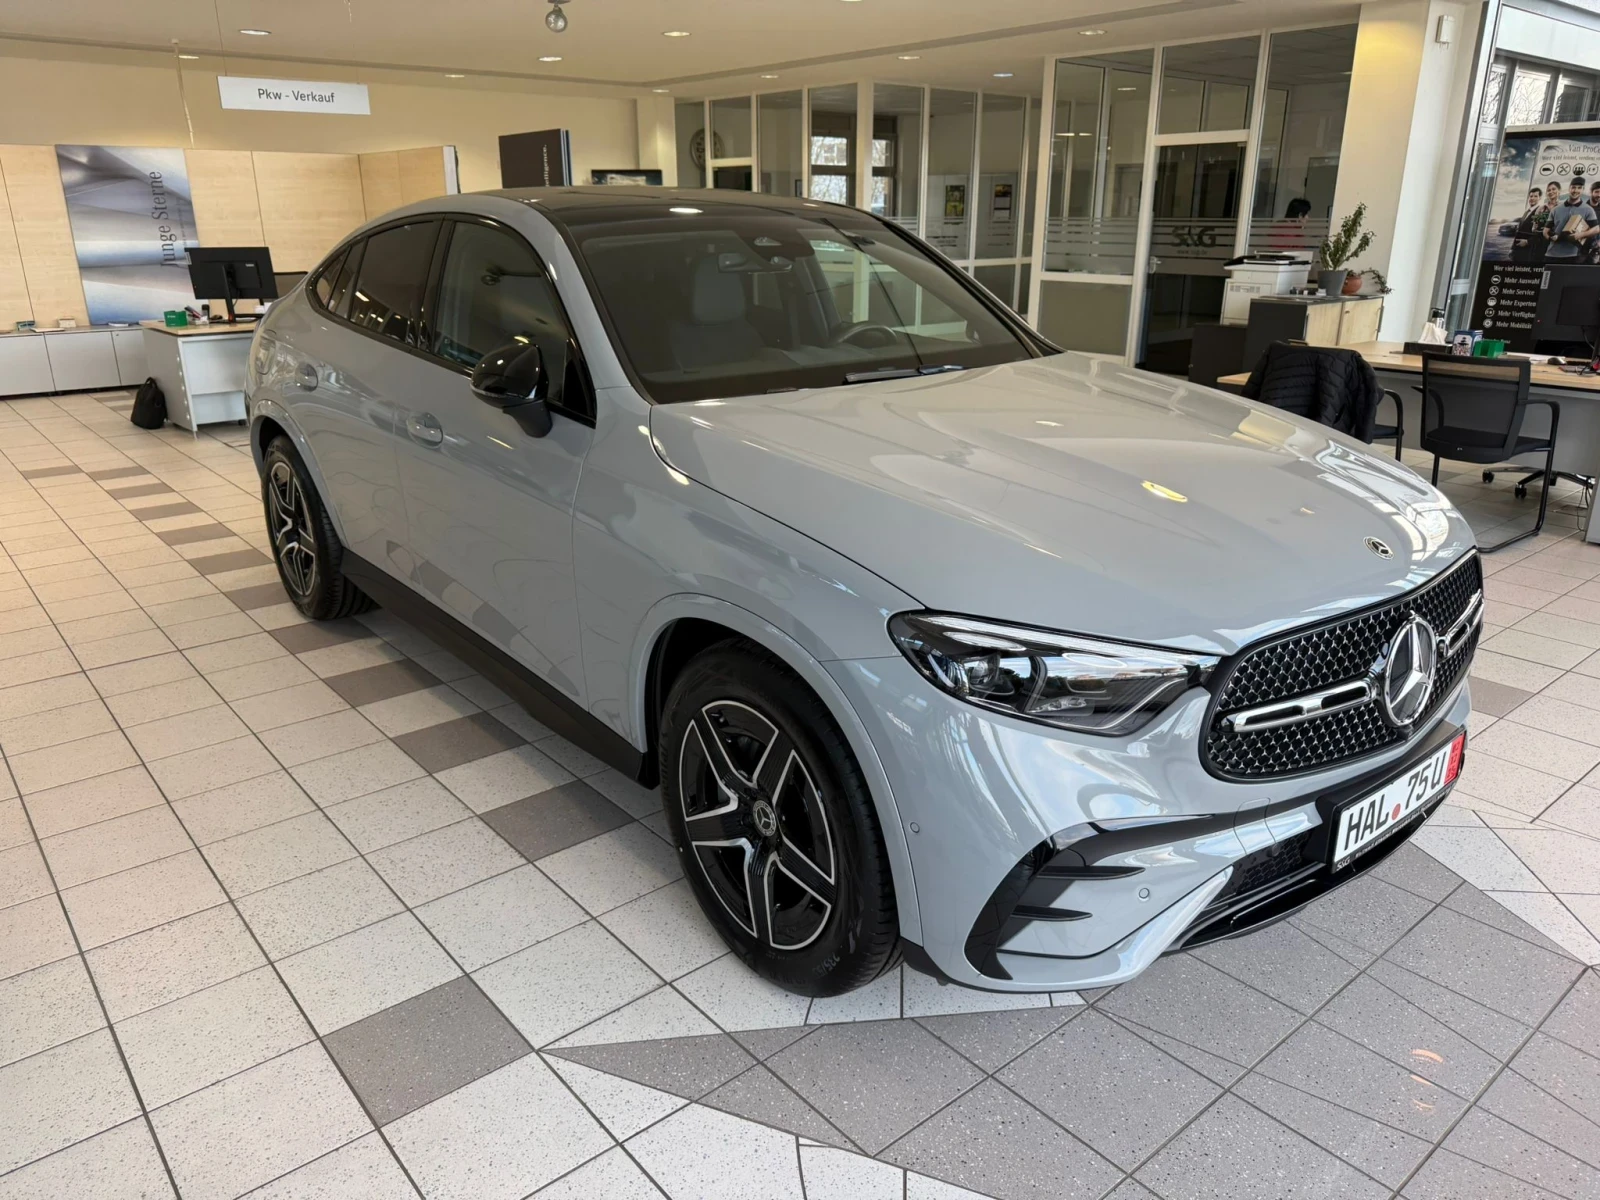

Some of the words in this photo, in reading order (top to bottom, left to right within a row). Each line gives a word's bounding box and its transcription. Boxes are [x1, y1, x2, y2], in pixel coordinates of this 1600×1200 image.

[257, 88, 282, 100] Pkw
[291, 89, 335, 103] Verkauf
[149, 171, 169, 220] Sterne
[158, 225, 178, 267] Junge
[1344, 794, 1389, 851] HAL
[1405, 751, 1447, 811] 75U
